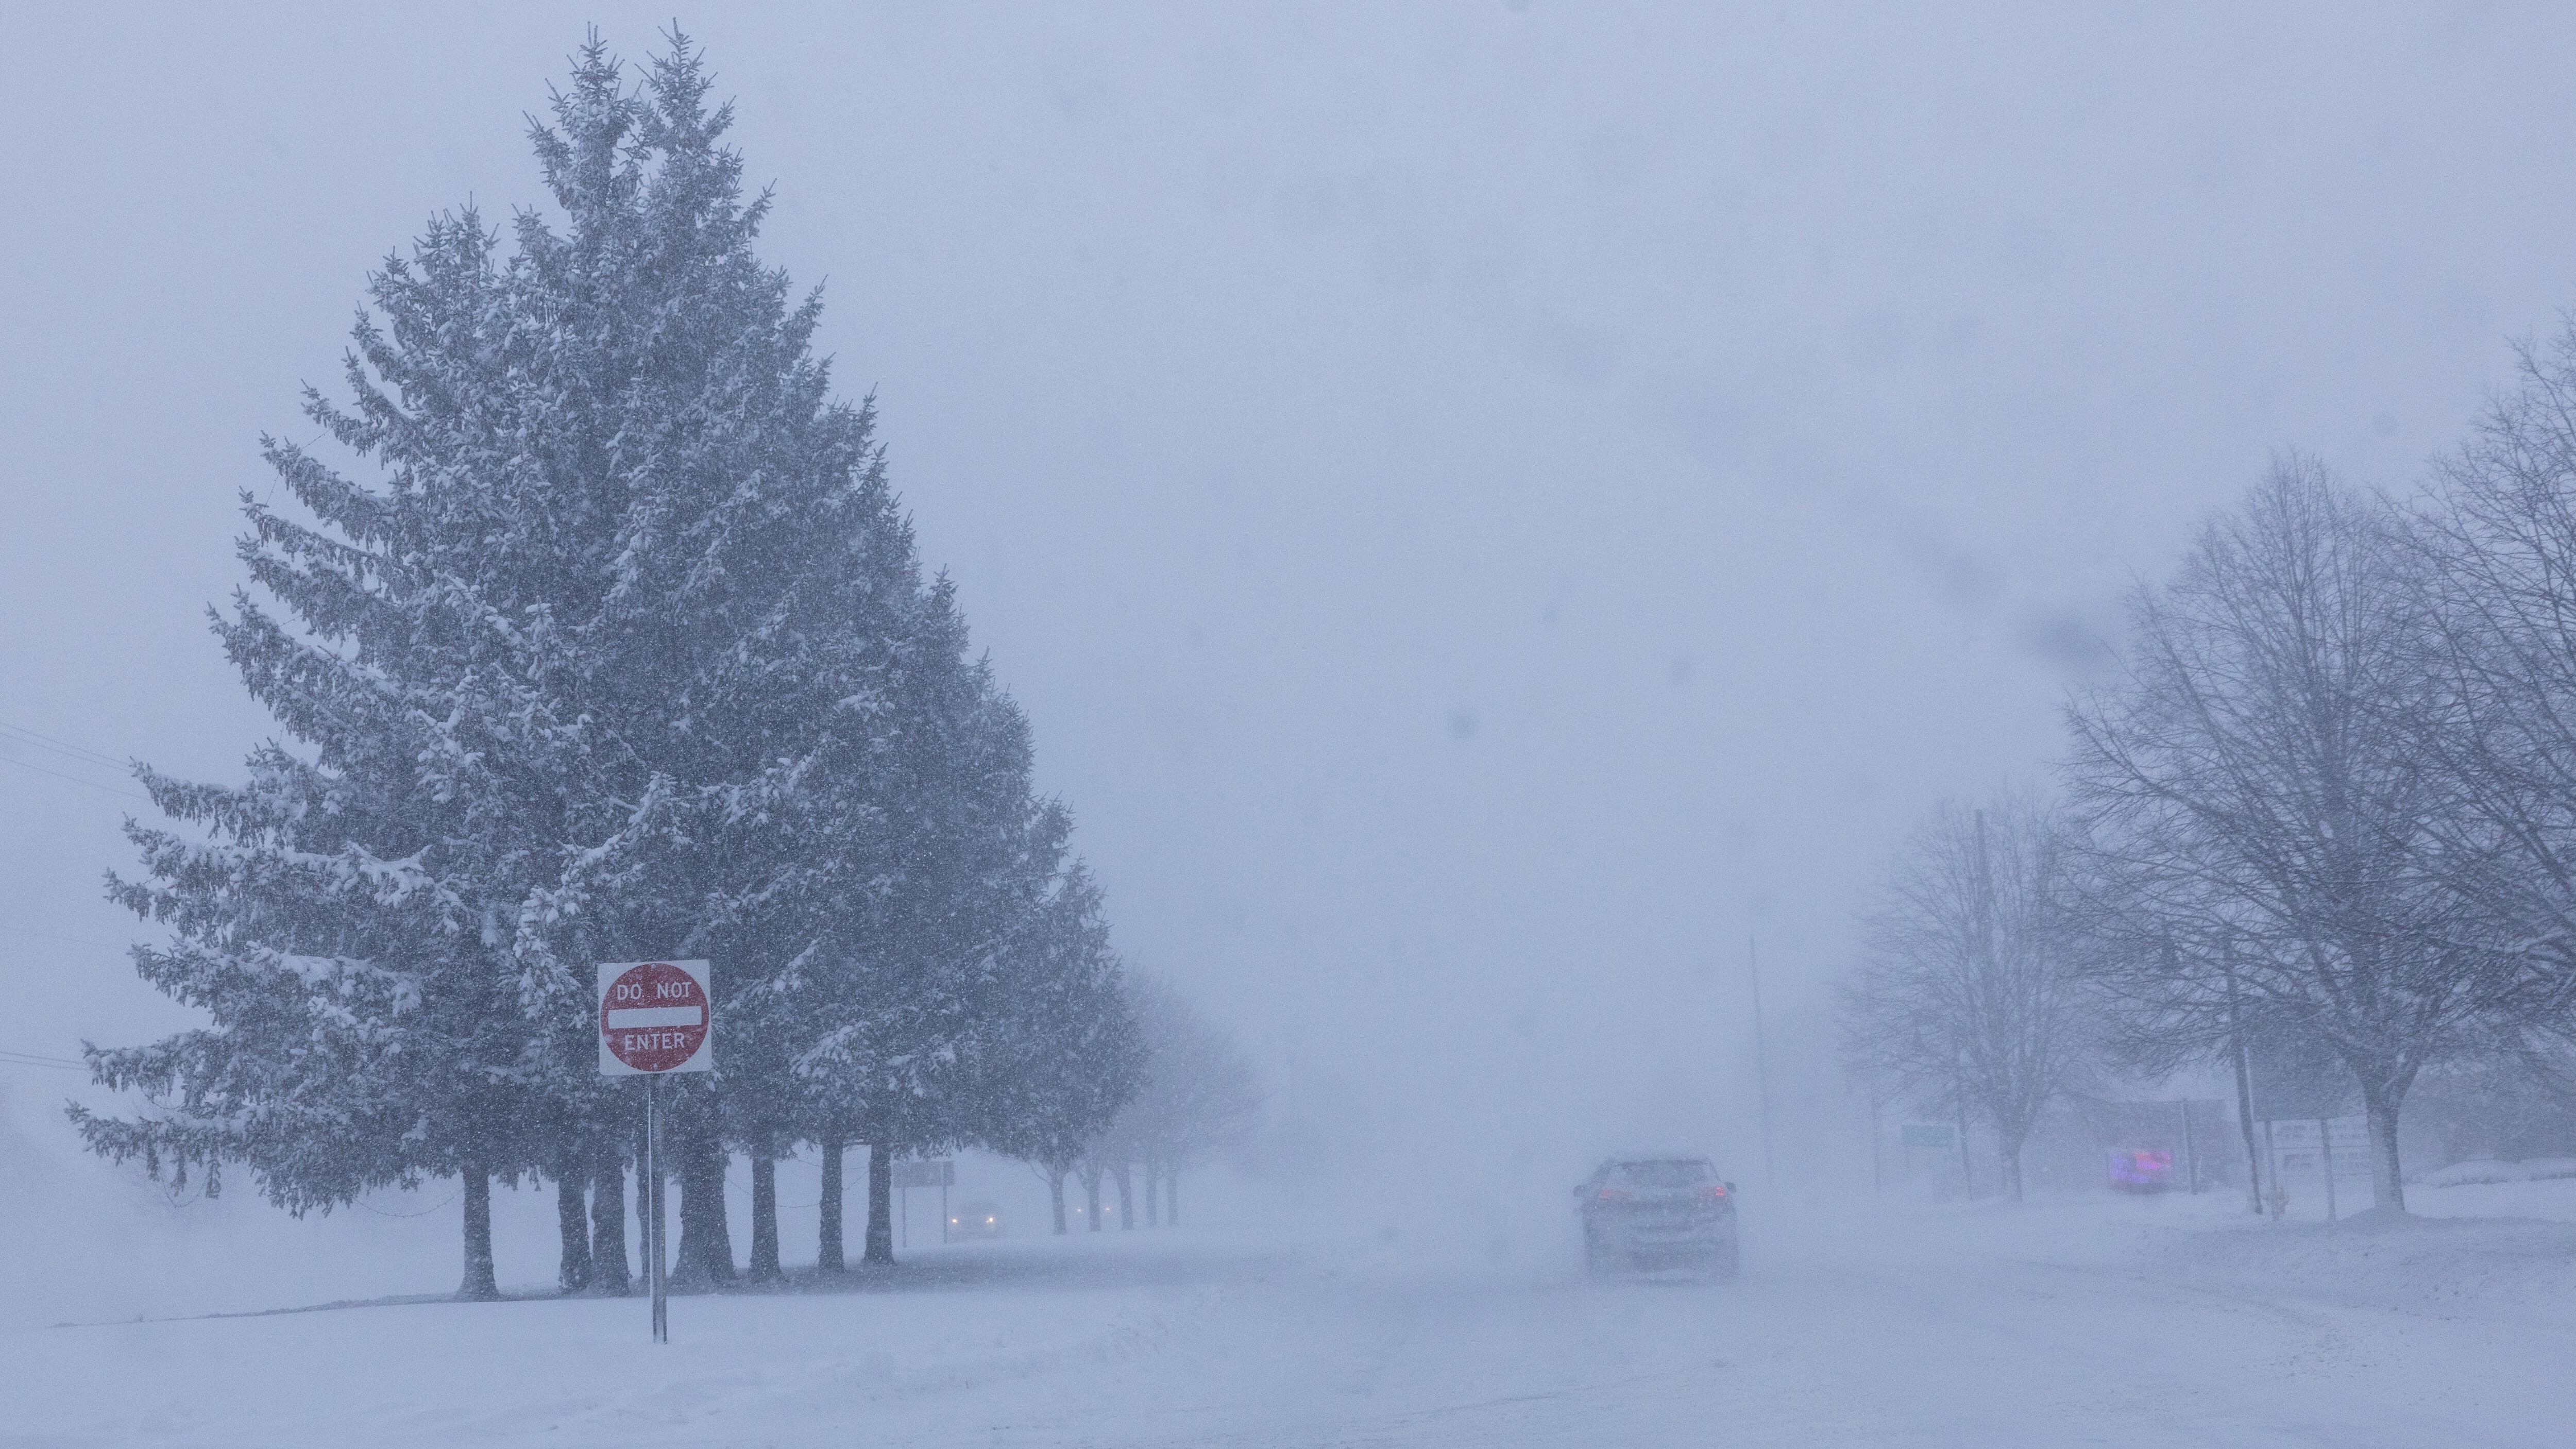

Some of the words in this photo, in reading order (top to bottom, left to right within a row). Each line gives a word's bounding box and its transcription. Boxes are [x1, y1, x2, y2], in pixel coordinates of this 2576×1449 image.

[617, 983, 642, 1000] DO
[657, 981, 692, 999] NOT
[624, 1032, 685, 1051] ENTER
